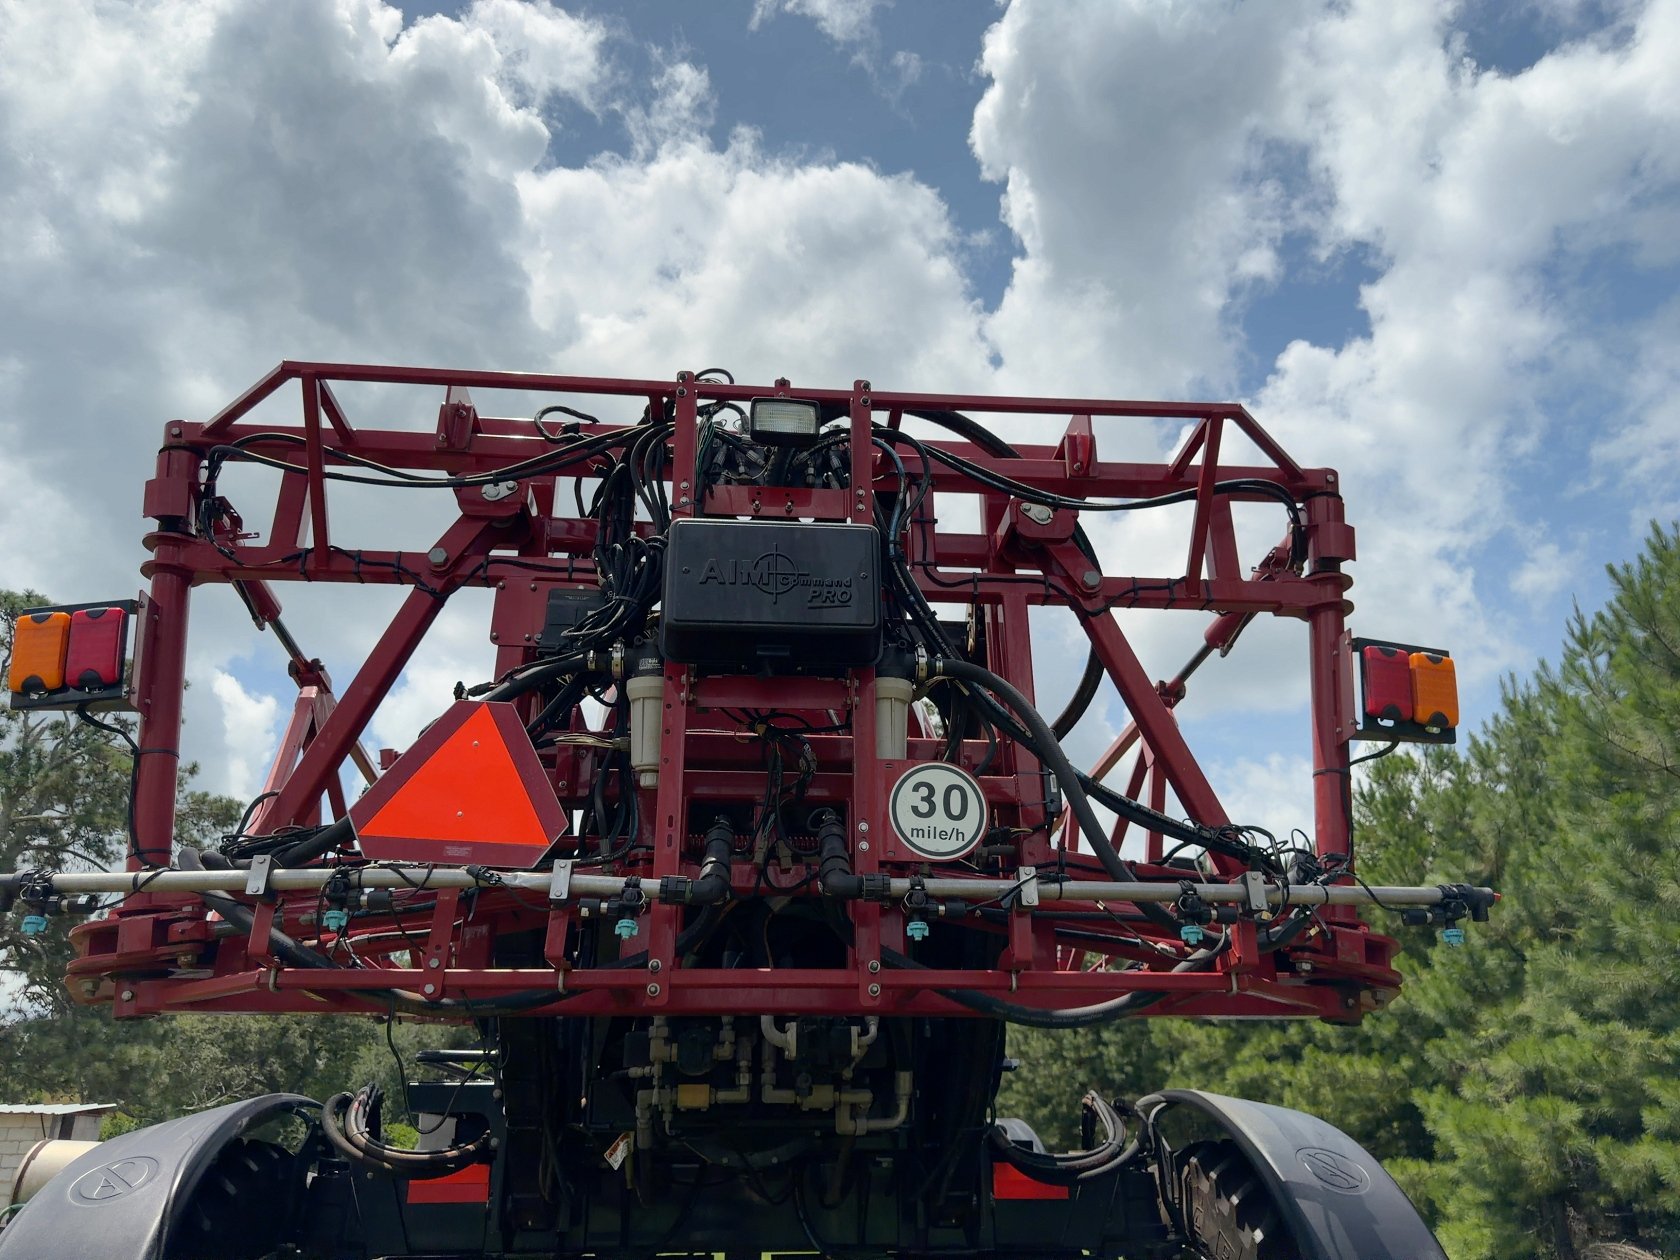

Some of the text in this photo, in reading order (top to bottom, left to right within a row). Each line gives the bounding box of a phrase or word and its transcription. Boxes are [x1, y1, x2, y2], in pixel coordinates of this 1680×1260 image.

[699, 558, 770, 586] AIM
[807, 589, 852, 604] PRO
[911, 781, 968, 821] 30
[911, 826, 965, 841] mile/h
